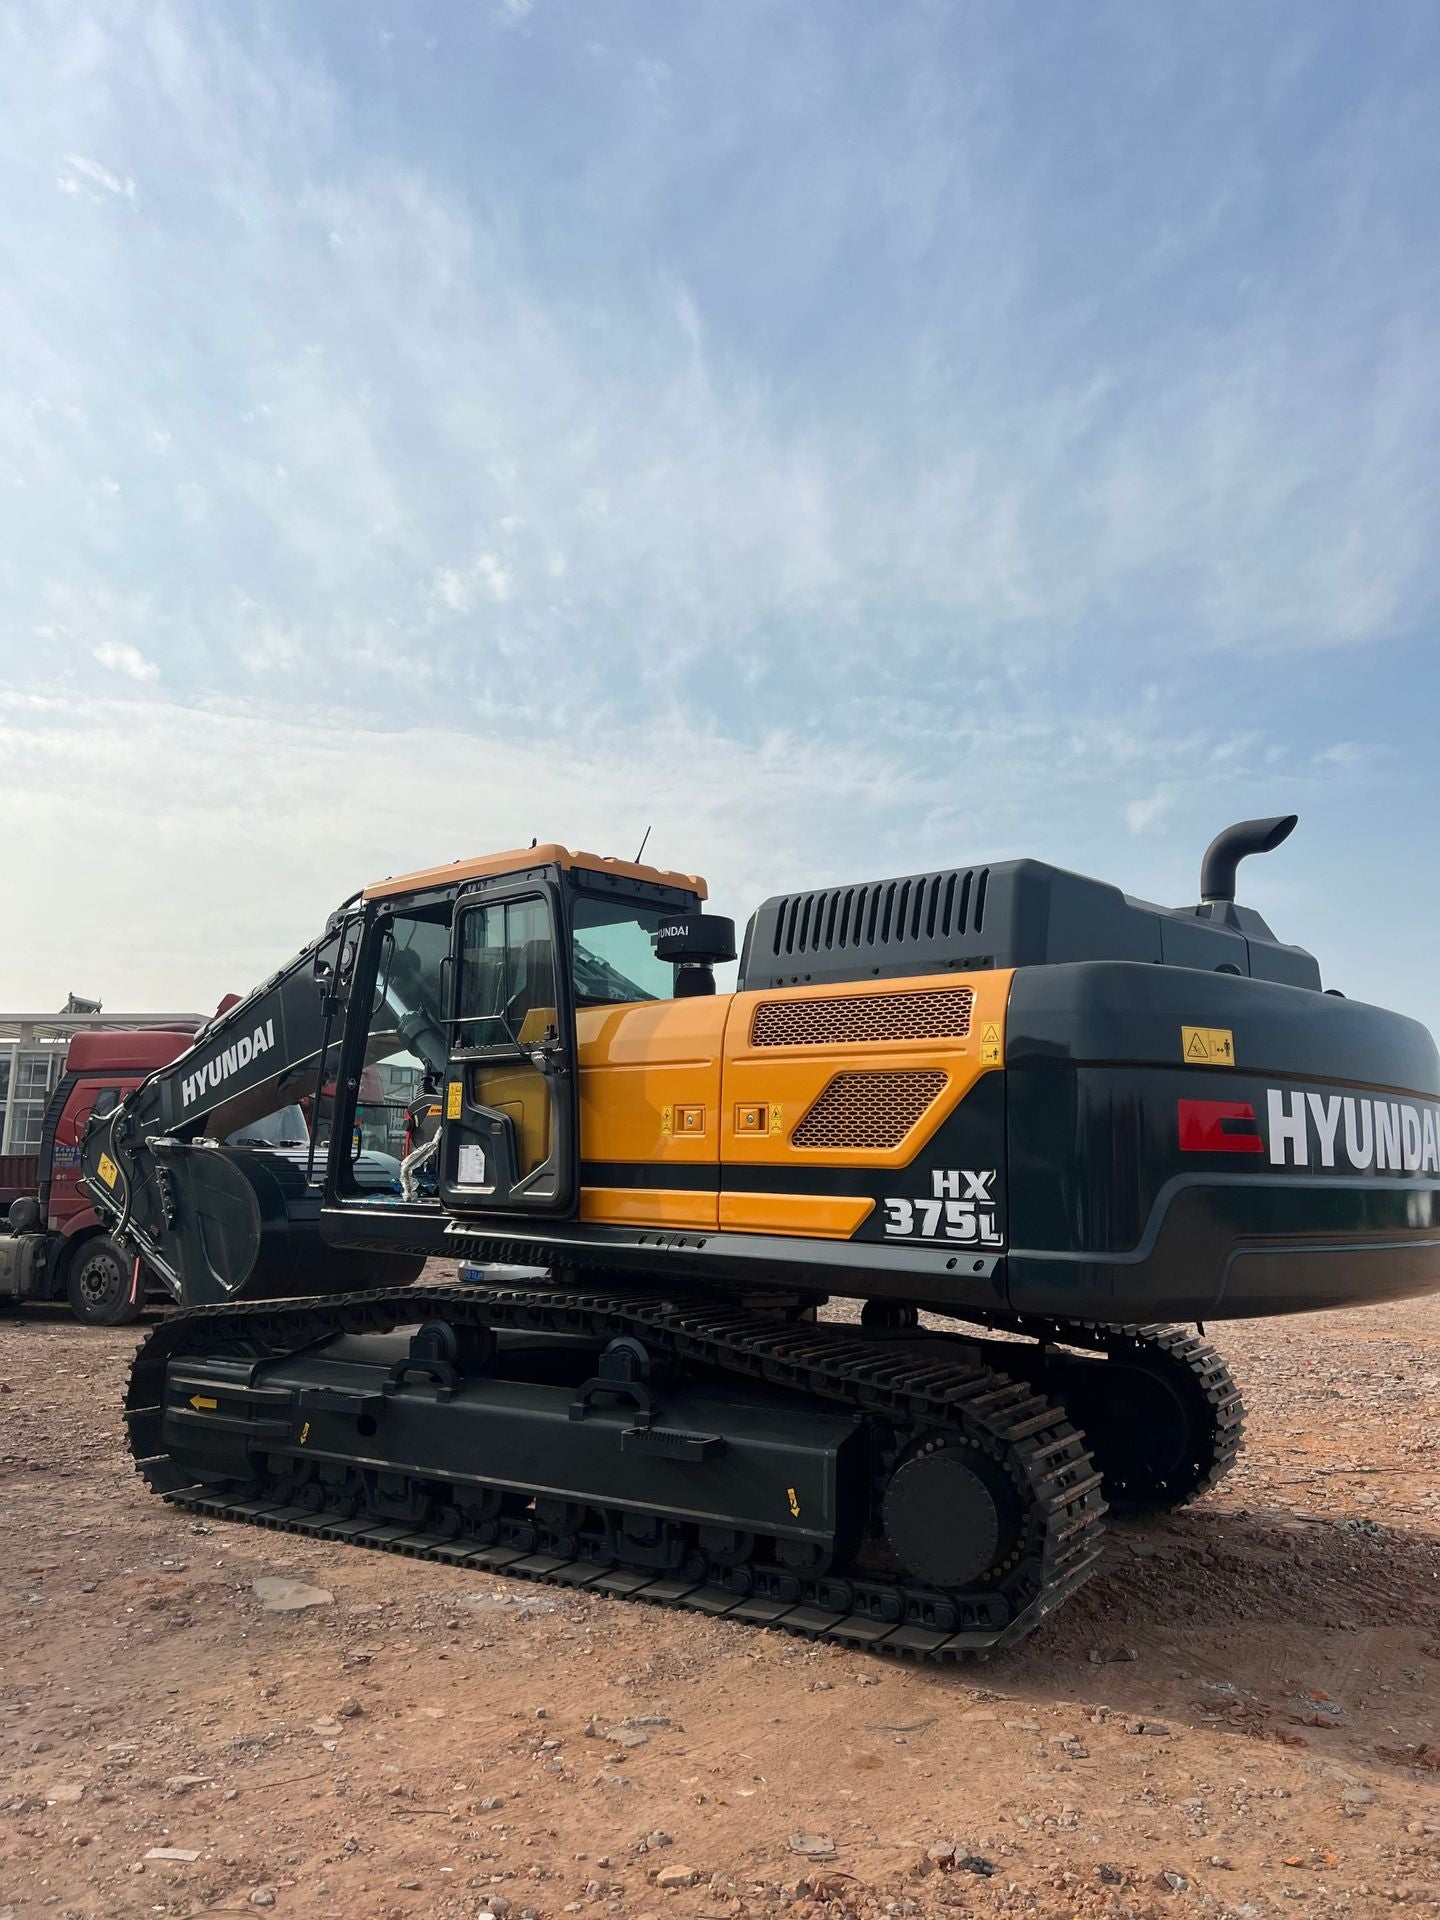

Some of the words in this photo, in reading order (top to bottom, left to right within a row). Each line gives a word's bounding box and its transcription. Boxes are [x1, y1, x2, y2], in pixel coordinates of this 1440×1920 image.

[182, 1019, 275, 1107] HYUNDAI
[932, 1169, 996, 1205] HX
[883, 1198, 1003, 1246] 375L
